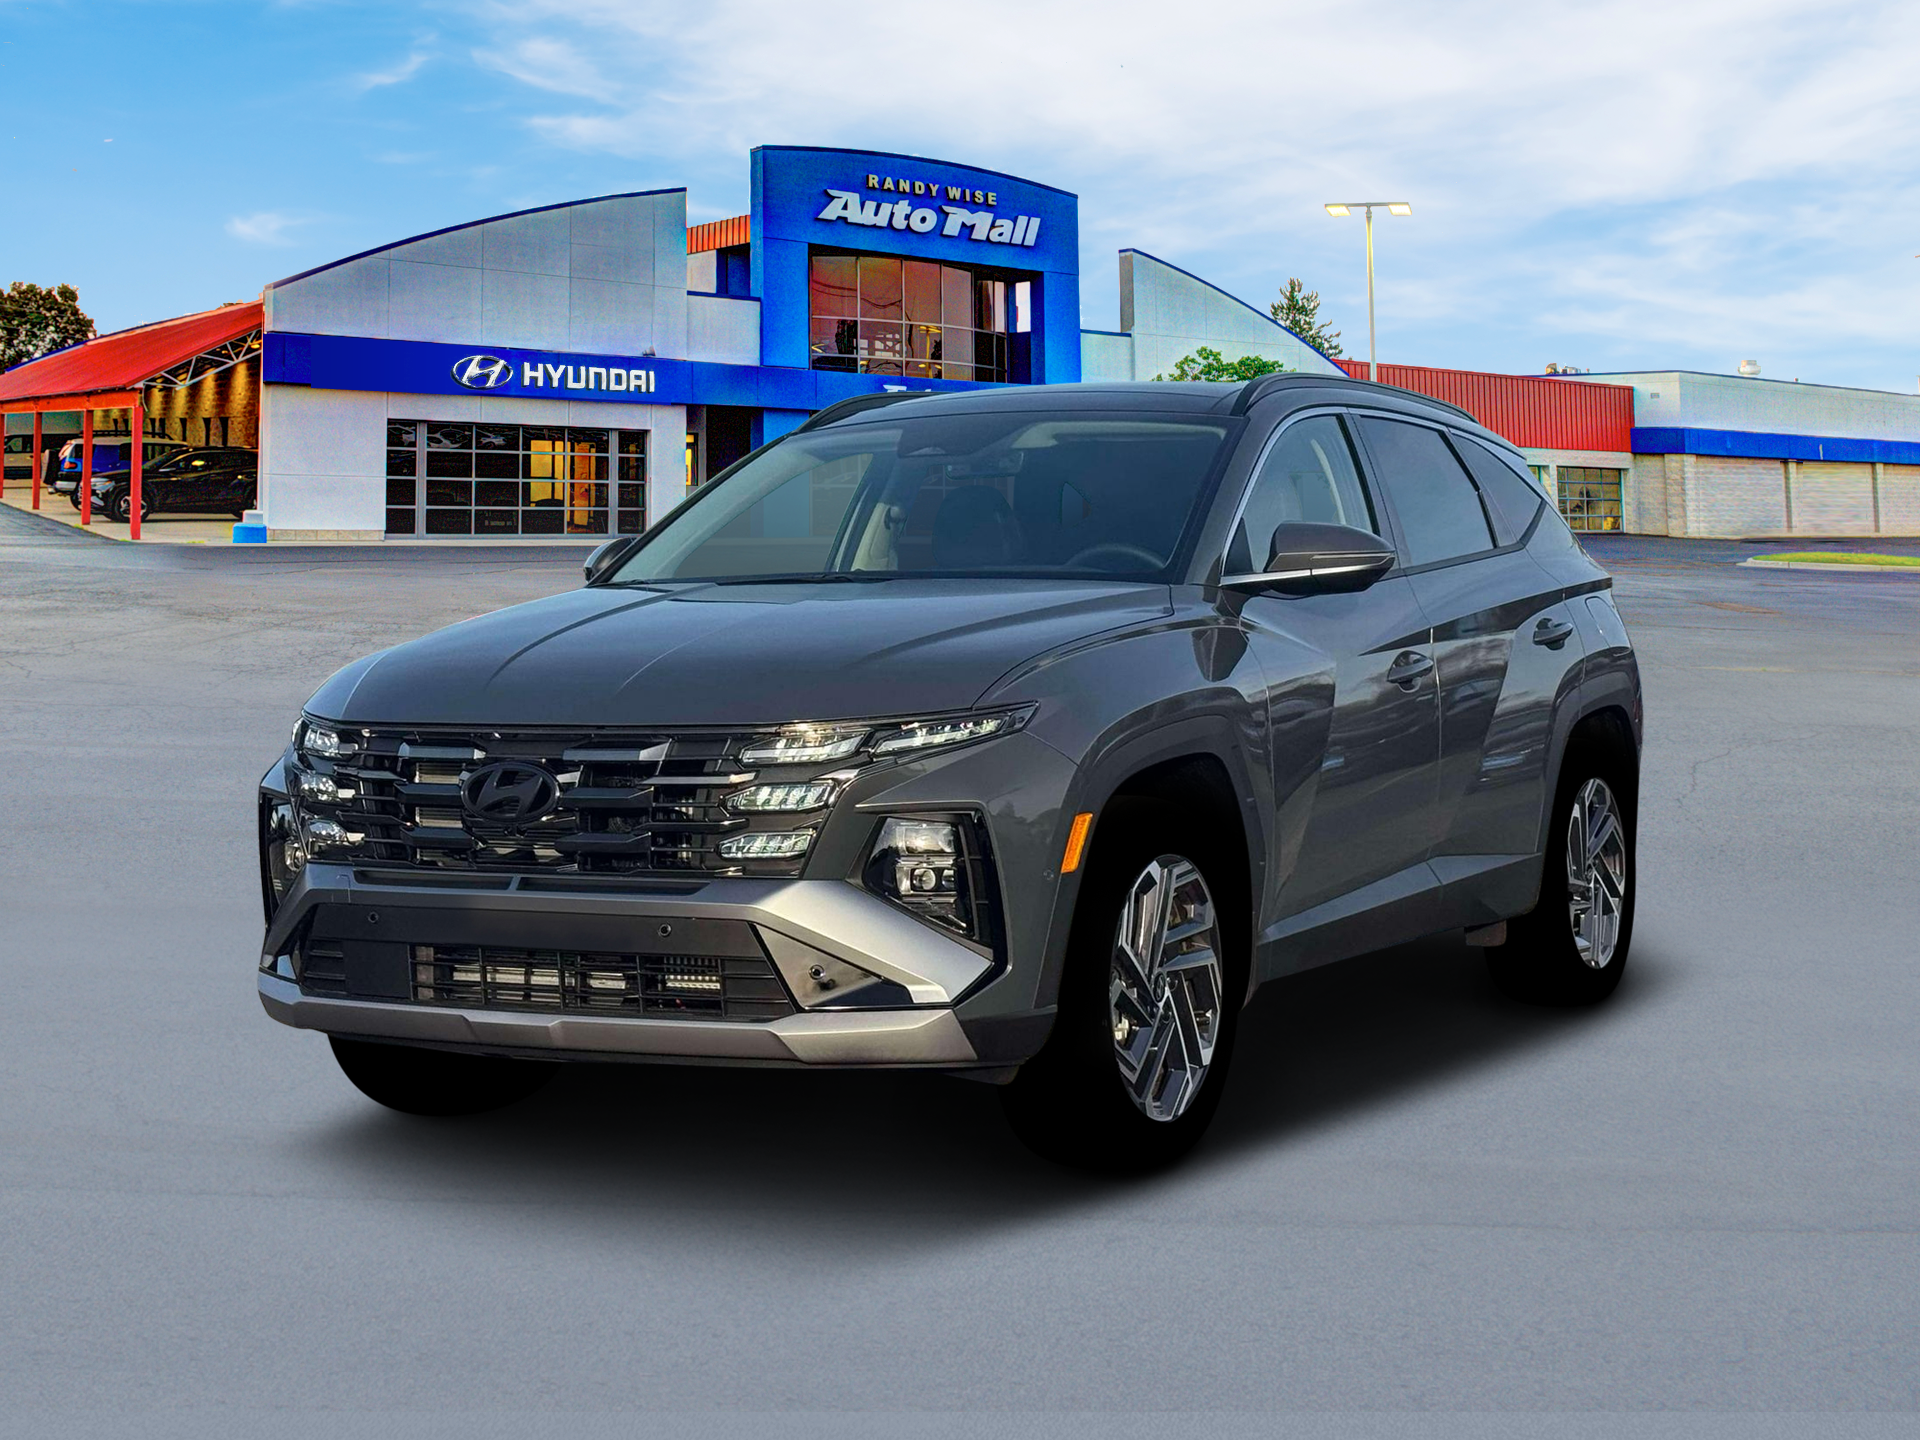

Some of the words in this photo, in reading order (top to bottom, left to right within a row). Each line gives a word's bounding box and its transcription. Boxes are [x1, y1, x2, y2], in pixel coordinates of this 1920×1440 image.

[866, 173, 940, 197] RANDY
[946, 185, 998, 206] WISE
[815, 188, 938, 233] Auto
[940, 204, 1042, 247] Mall
[521, 361, 656, 393] HYUNDAI
